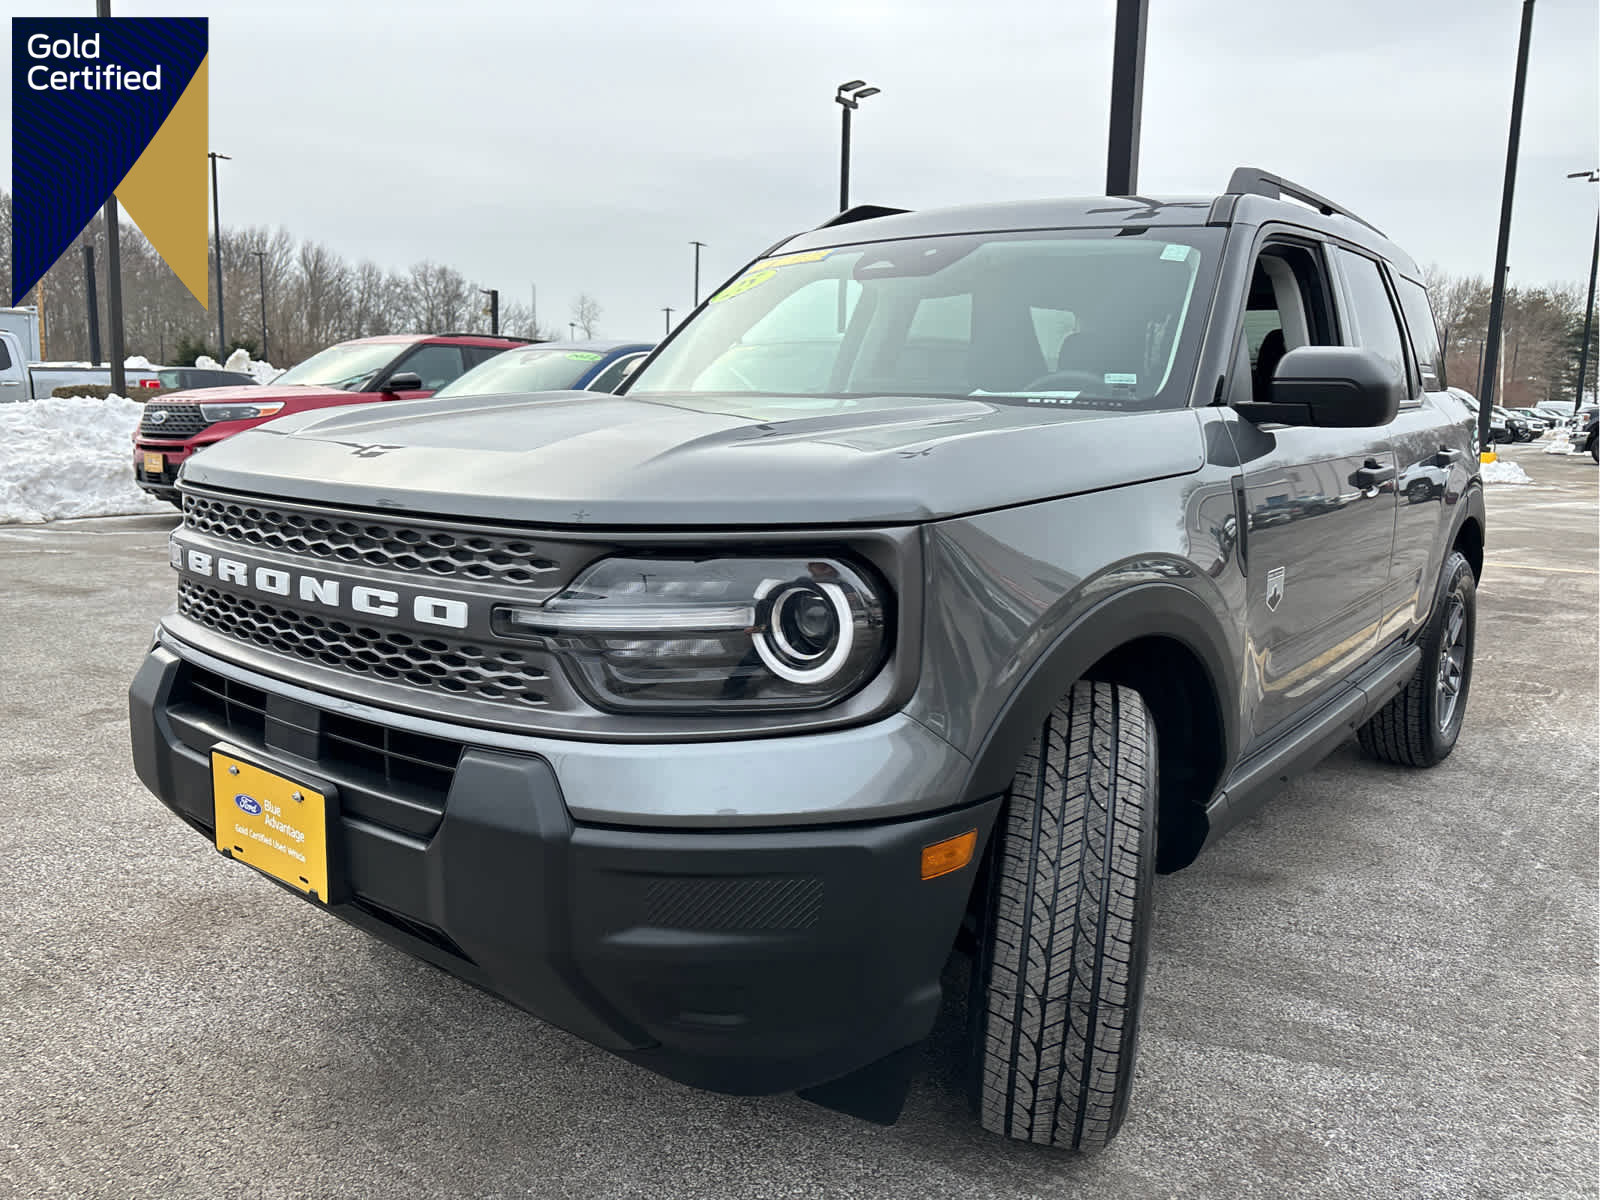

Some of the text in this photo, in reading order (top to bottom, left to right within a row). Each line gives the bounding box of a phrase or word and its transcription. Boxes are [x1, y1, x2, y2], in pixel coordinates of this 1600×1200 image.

[188, 549, 468, 628] BRONCO
[263, 799, 281, 817] Blue
[234, 823, 249, 836] Gold
[248, 829, 273, 847] Certified
[264, 814, 305, 843] Advantage
